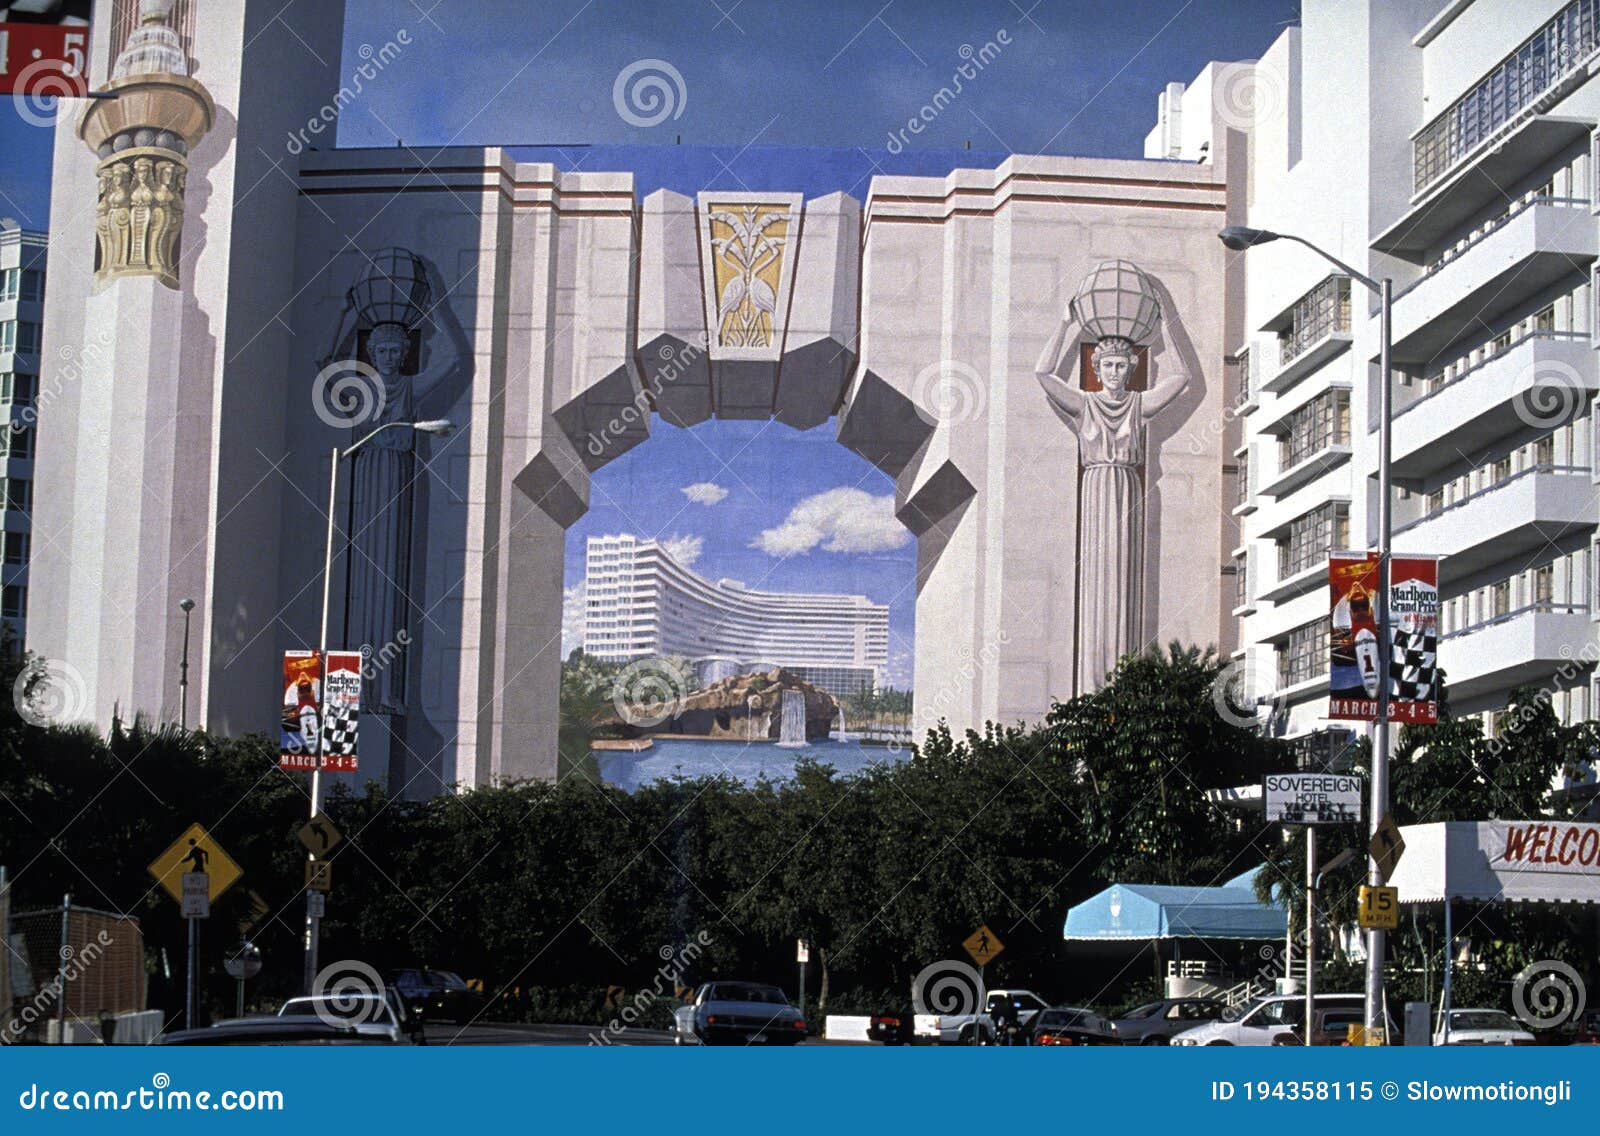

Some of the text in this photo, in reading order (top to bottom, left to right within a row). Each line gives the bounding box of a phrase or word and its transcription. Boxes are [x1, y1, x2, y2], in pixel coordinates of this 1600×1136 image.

[1391, 585, 1436, 602] Marlboro
[1391, 601, 1436, 613] Grand Prix
[1330, 700, 1377, 716] MARCH
[281, 755, 316, 767] MARCH
[1267, 777, 1360, 792] SOVEREIGN
[1295, 793, 1328, 803] HOTEL
[1503, 823, 1600, 867] WELCO
[1365, 891, 1392, 911] 15
[1366, 914, 1392, 923] MPH
